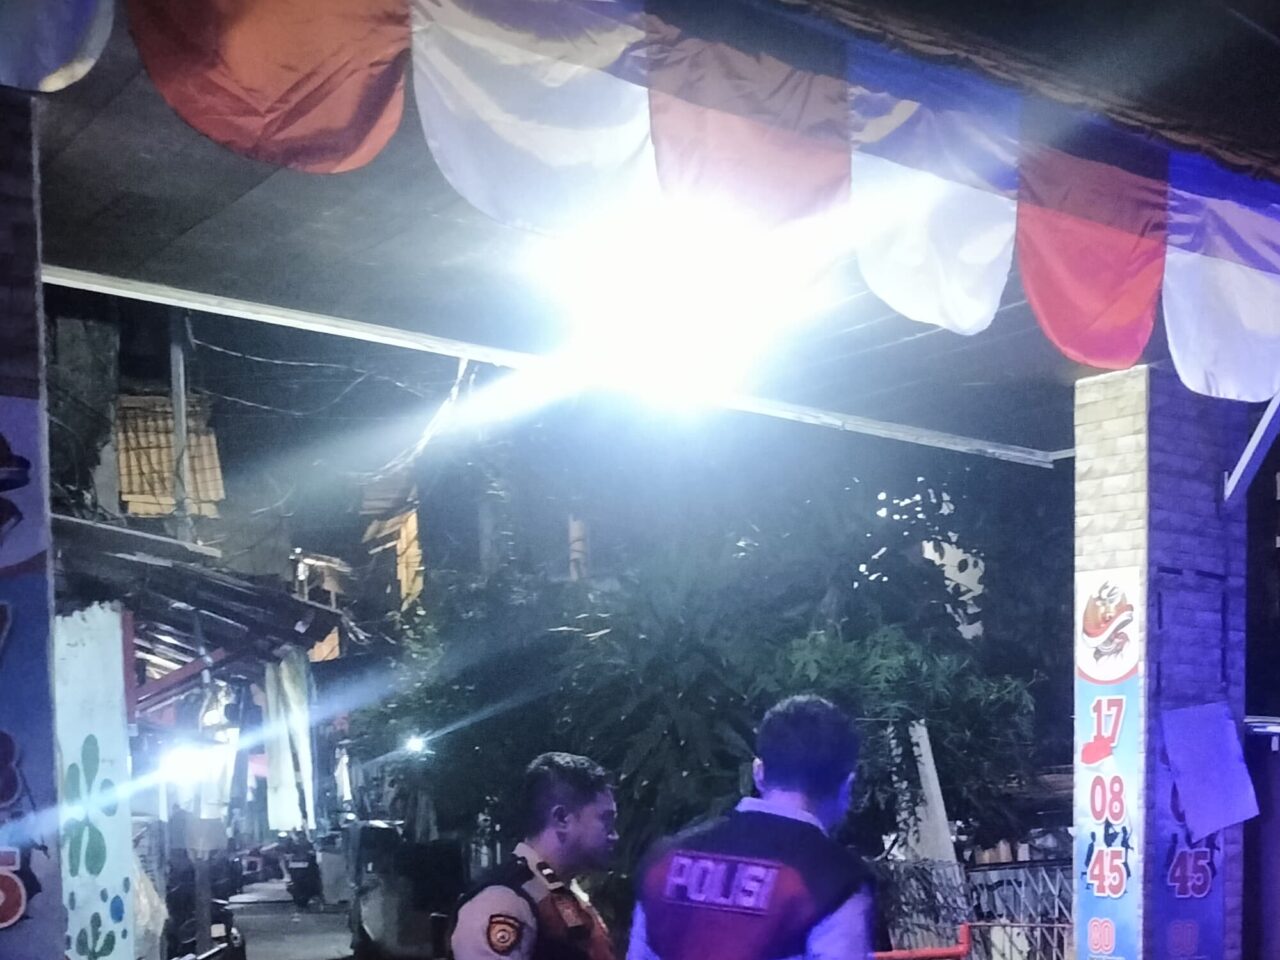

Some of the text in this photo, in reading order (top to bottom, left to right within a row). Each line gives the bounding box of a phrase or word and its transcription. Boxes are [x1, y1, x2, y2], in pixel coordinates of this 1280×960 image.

[1091, 696, 1126, 747] 17
[1090, 775, 1125, 823] 08
[665, 856, 779, 908] POLISI
[1087, 849, 1127, 897] 45
[1168, 849, 1212, 897] 45
